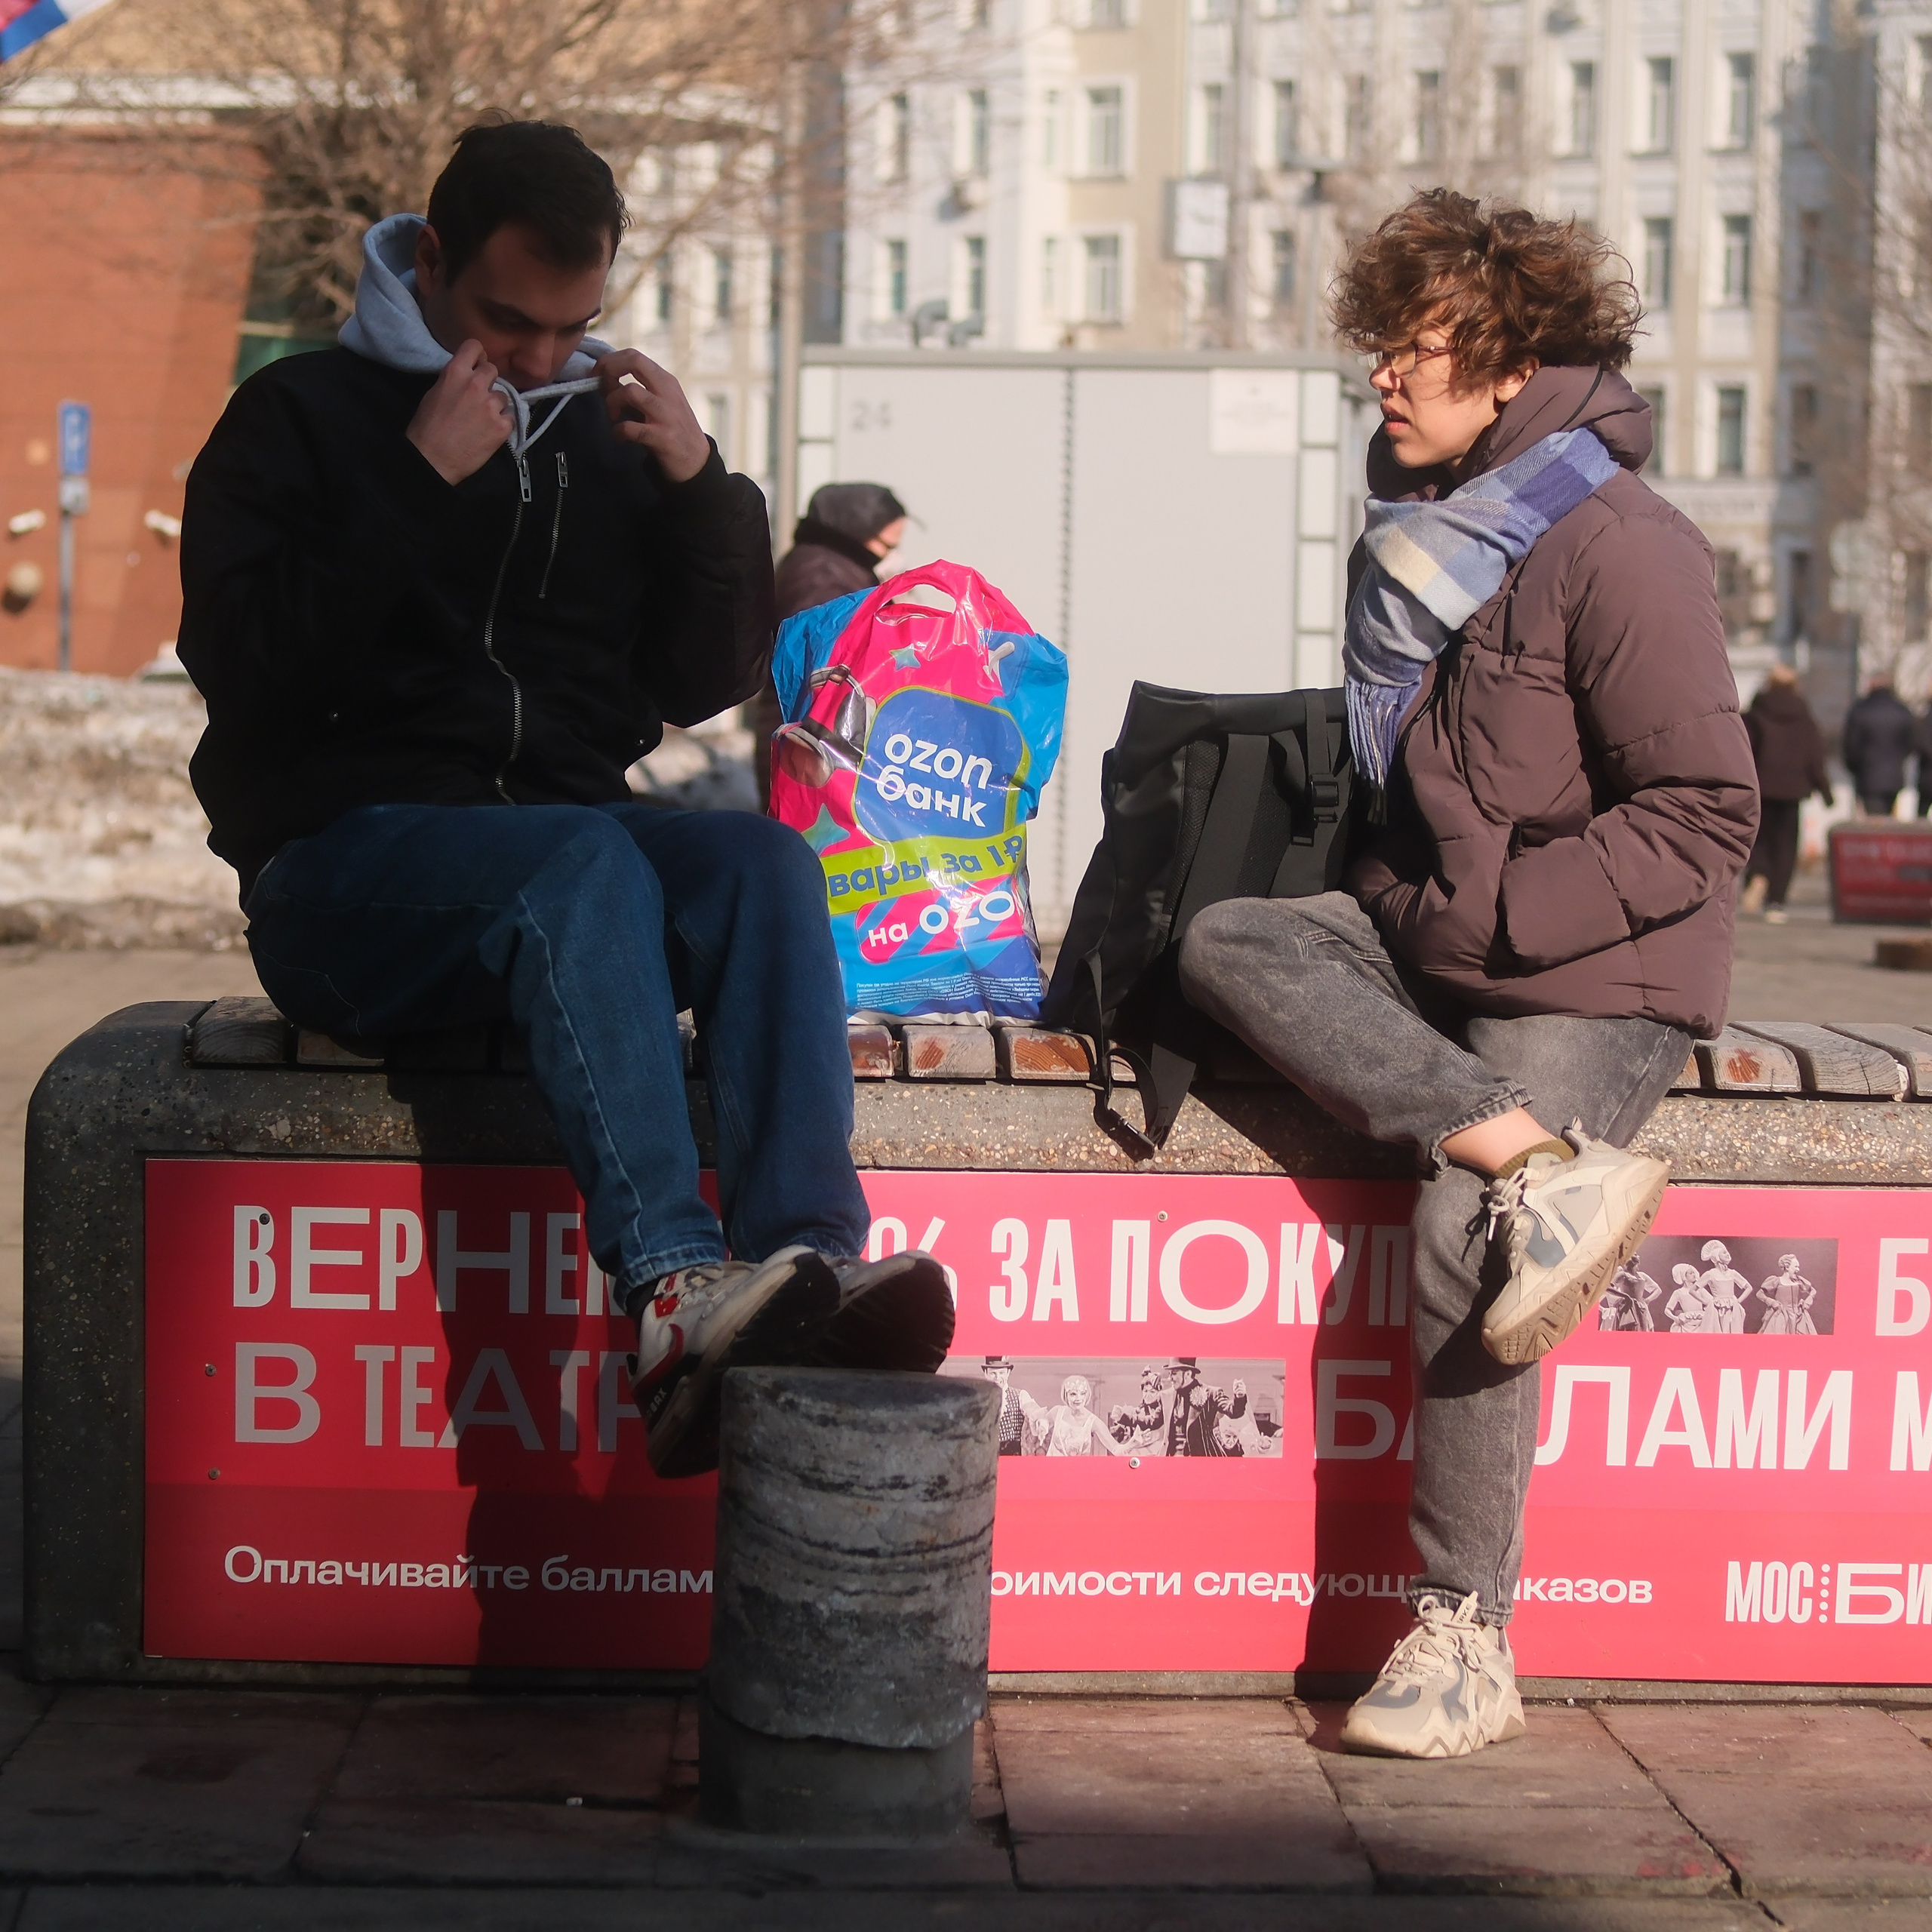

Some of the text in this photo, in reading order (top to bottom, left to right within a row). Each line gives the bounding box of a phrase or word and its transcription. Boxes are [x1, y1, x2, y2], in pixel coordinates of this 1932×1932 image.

[884, 734, 993, 789] ozon
[876, 764, 987, 827] банк
[940, 853, 983, 873] за
[868, 922, 909, 946] на
[989, 1217, 1079, 1322] ЗА
[1109, 1219, 1406, 1327] ПОКУП
[1875, 1238, 1931, 1336] Б
[234, 1342, 321, 1444] В
[353, 1344, 641, 1453] ТЕАТР
[224, 1545, 529, 1590] Оплачивайте
[541, 1554, 713, 1595] баллам
[1193, 1571, 1414, 1607] следующ
